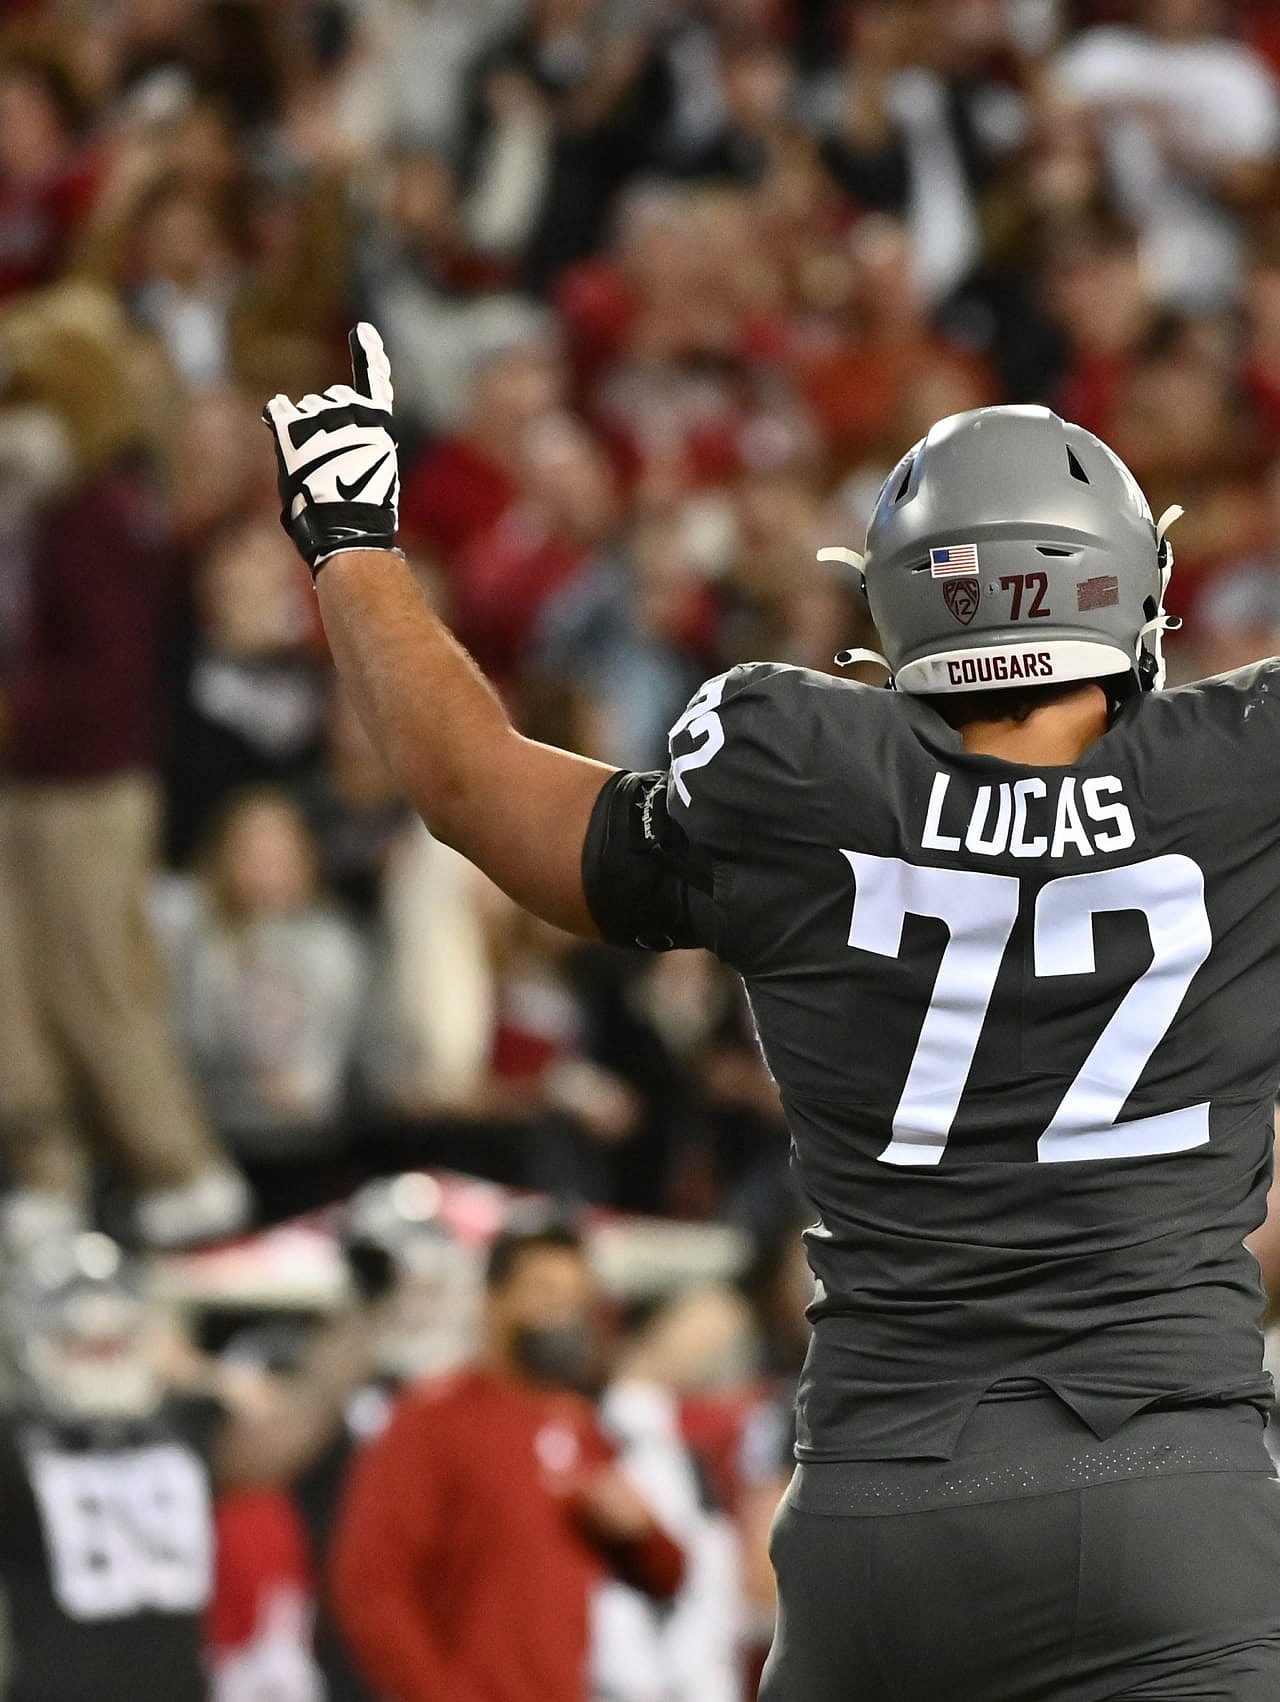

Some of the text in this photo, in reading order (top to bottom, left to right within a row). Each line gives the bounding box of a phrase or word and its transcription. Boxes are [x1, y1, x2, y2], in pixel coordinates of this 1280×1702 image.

[999, 571, 1051, 620] 72
[947, 652, 1053, 686] COUGARS
[921, 771, 1136, 858] LUCAS
[839, 849, 1213, 1166] 72
